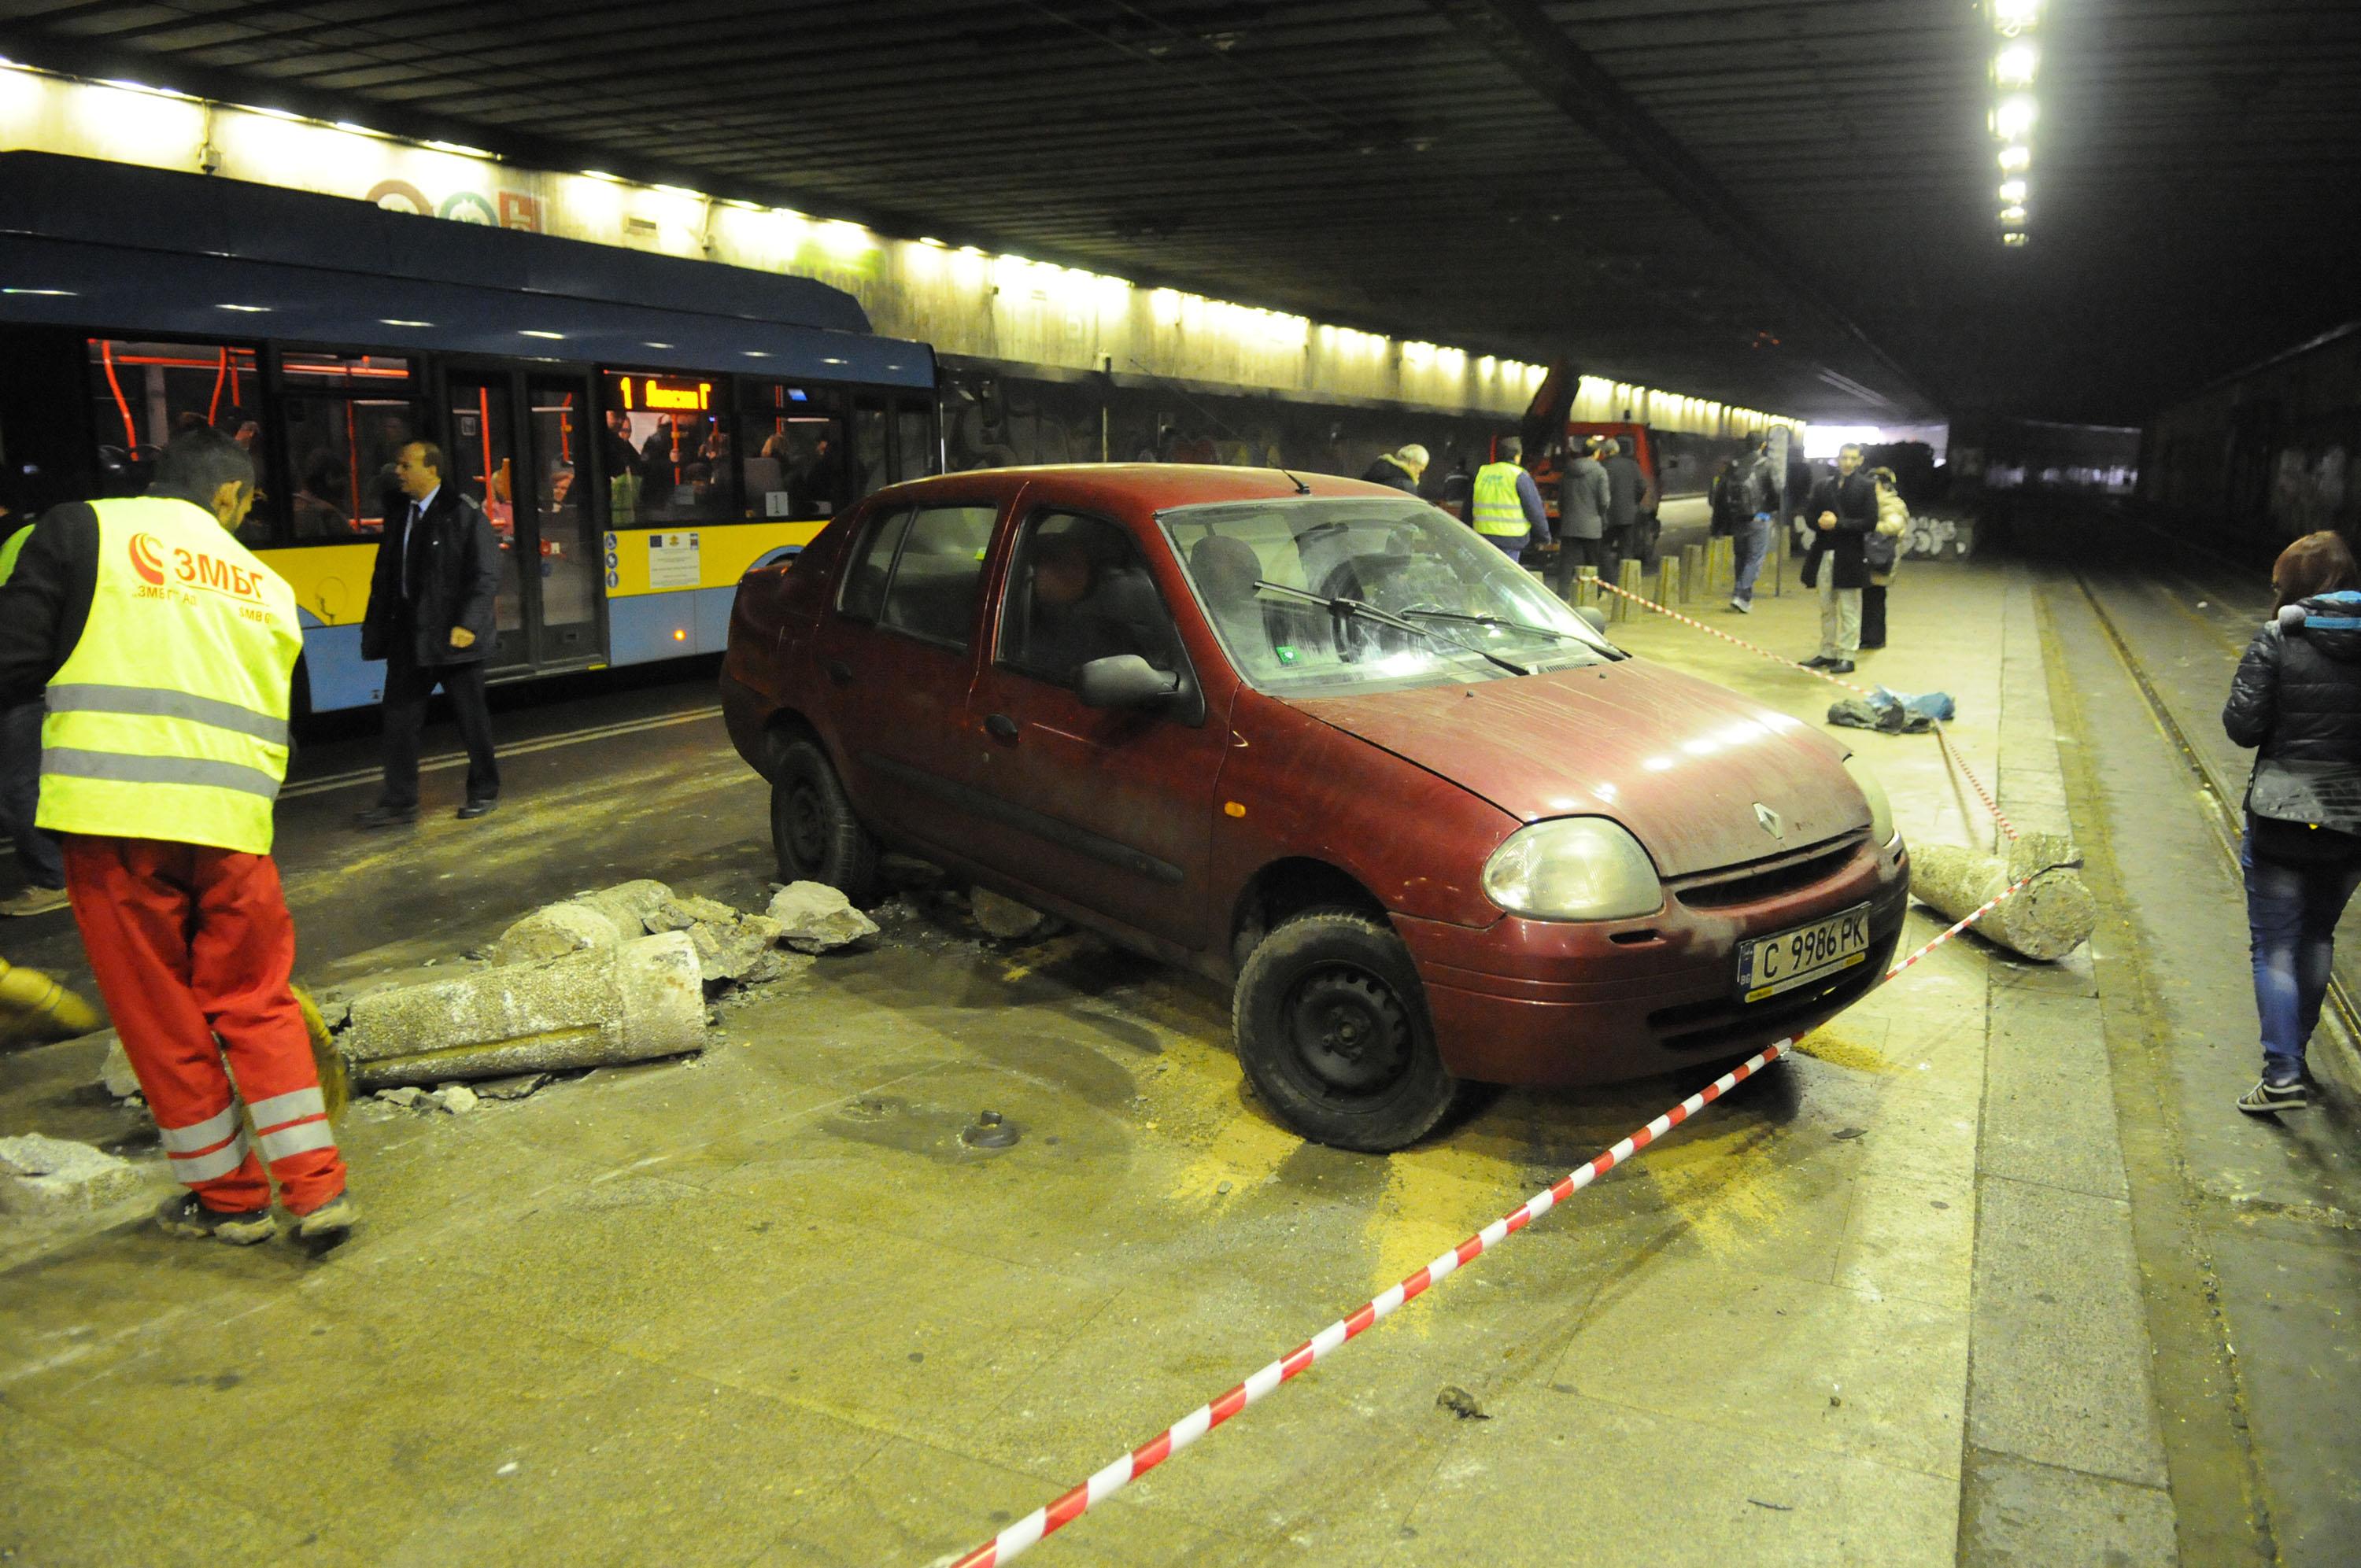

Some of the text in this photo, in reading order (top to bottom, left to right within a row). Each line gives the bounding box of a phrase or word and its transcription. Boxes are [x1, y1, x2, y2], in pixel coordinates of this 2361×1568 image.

[620, 377, 632, 410] 1
[175, 548, 263, 598] ЗМБГ
[1764, 913, 1865, 978] C 9986 PK
[1740, 973, 1751, 985] BG
